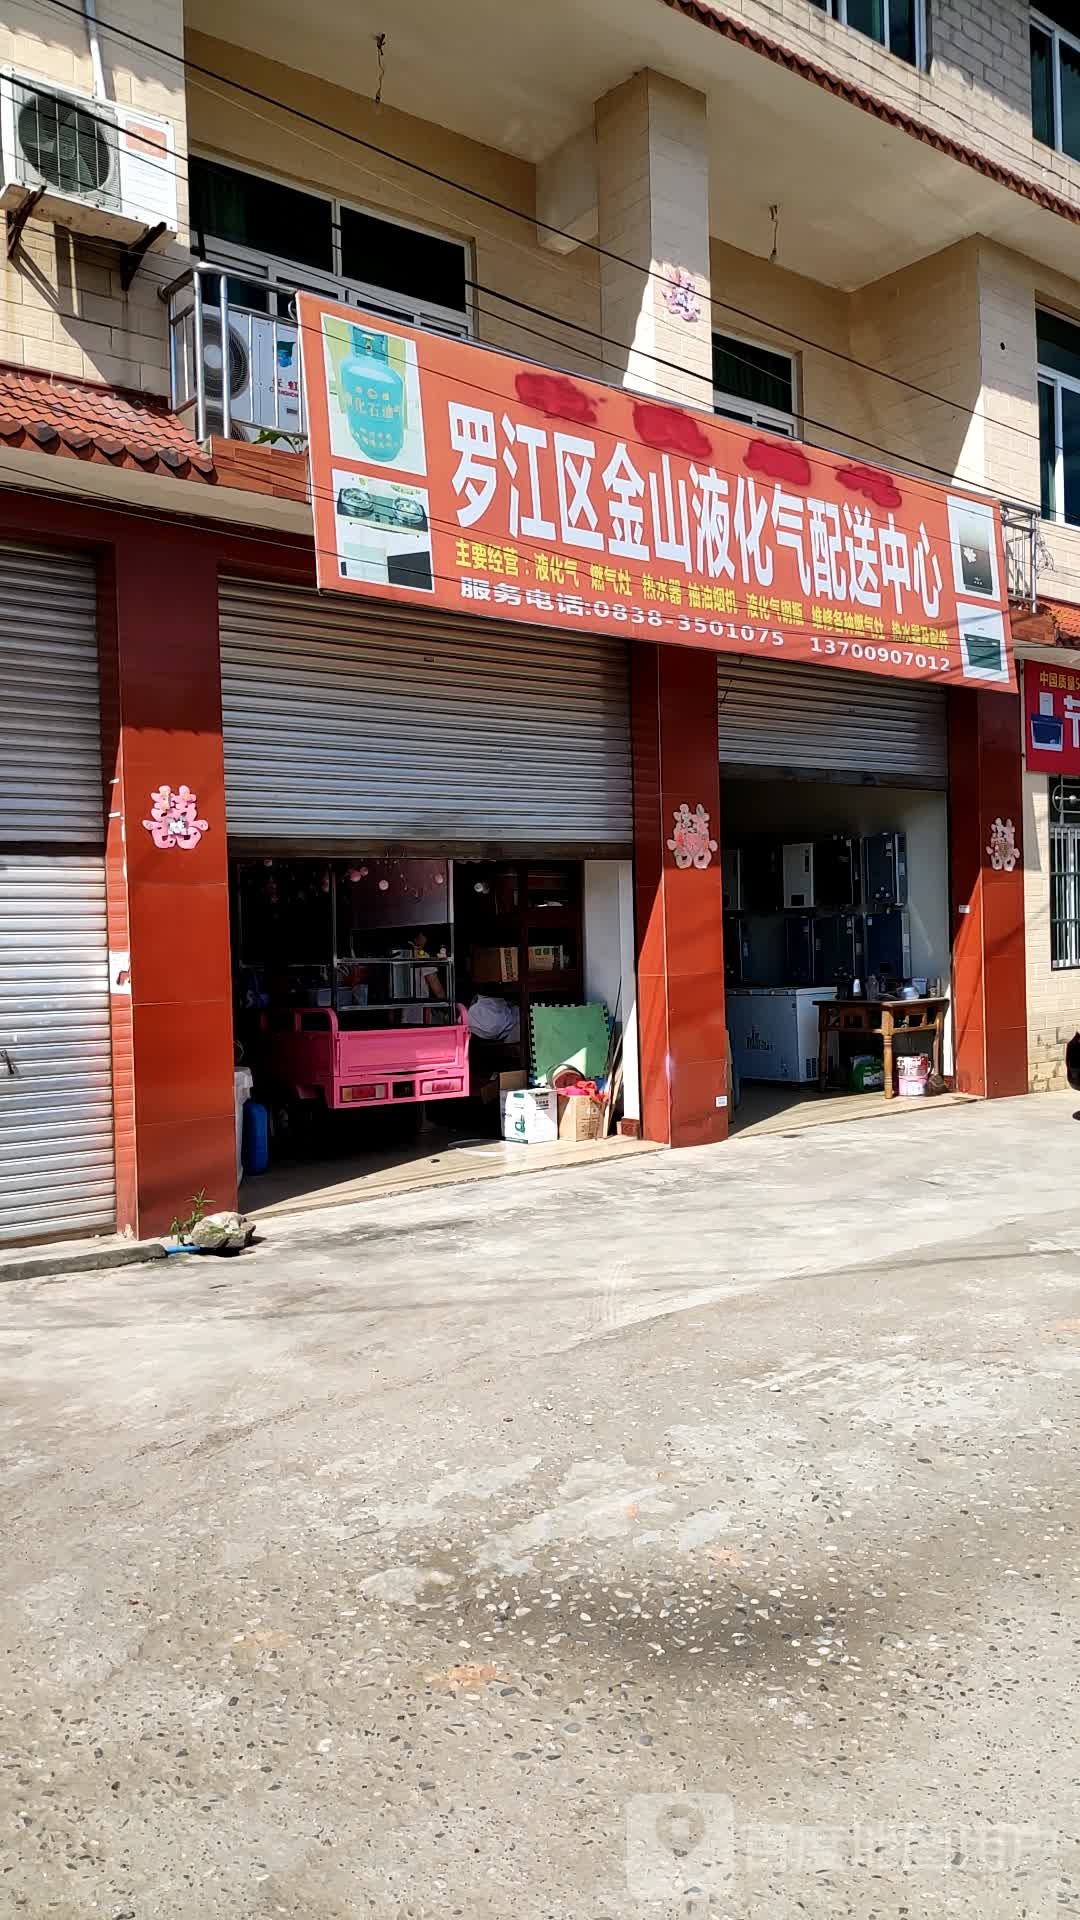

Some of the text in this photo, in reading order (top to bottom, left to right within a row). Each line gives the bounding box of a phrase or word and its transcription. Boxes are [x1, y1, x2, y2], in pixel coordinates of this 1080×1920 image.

[448, 400, 943, 618] 罗江区金山液化气配送中心
[810, 636, 951, 672] 13700907012
